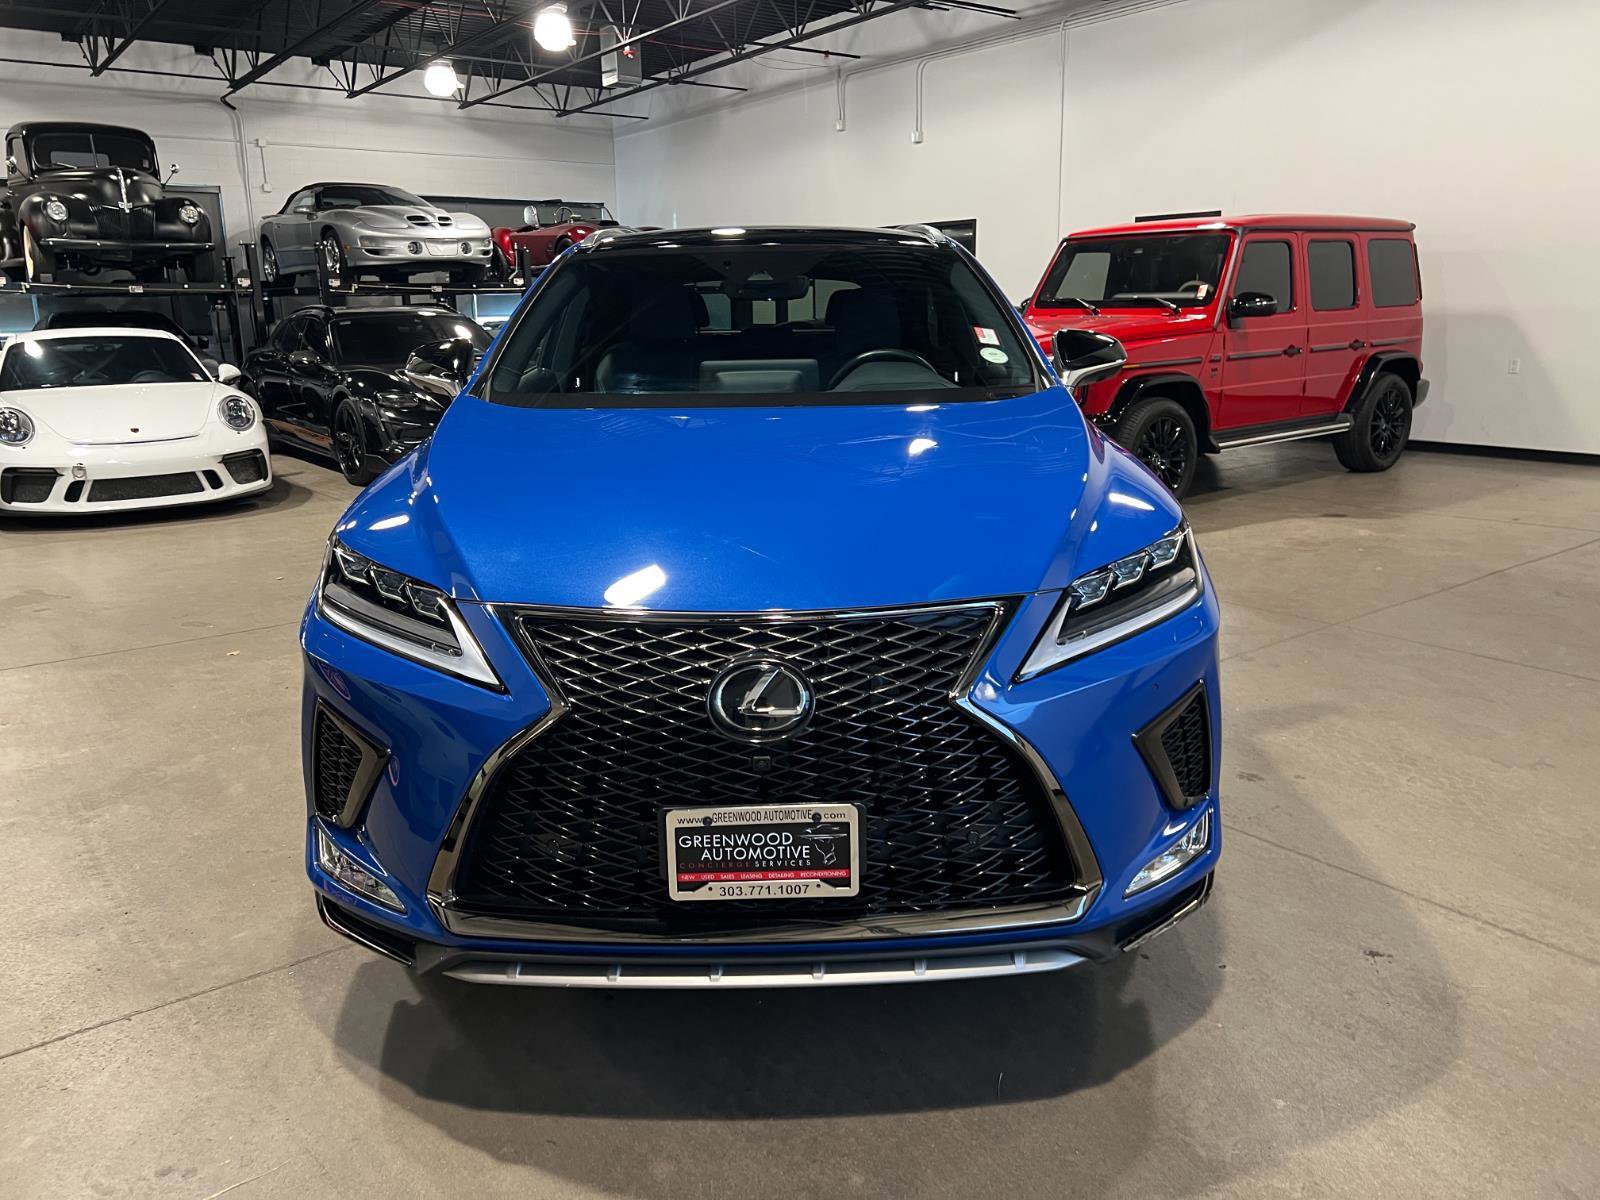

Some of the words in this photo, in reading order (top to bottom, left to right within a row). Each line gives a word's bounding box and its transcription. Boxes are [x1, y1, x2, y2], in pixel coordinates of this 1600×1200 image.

[712, 811, 762, 824] GREENWOOD
[764, 809, 813, 821] AUTOMOTIVE
[678, 832, 793, 848] GREENWOOD
[701, 845, 811, 861] AUTOMOTIVE
[680, 861, 751, 869] CONCIERGE
[755, 859, 811, 867] SERVICES
[768, 871, 795, 879] DETAILING
[800, 869, 847, 877] RECONDITIONING
[719, 884, 810, 897] 303.771.1007
